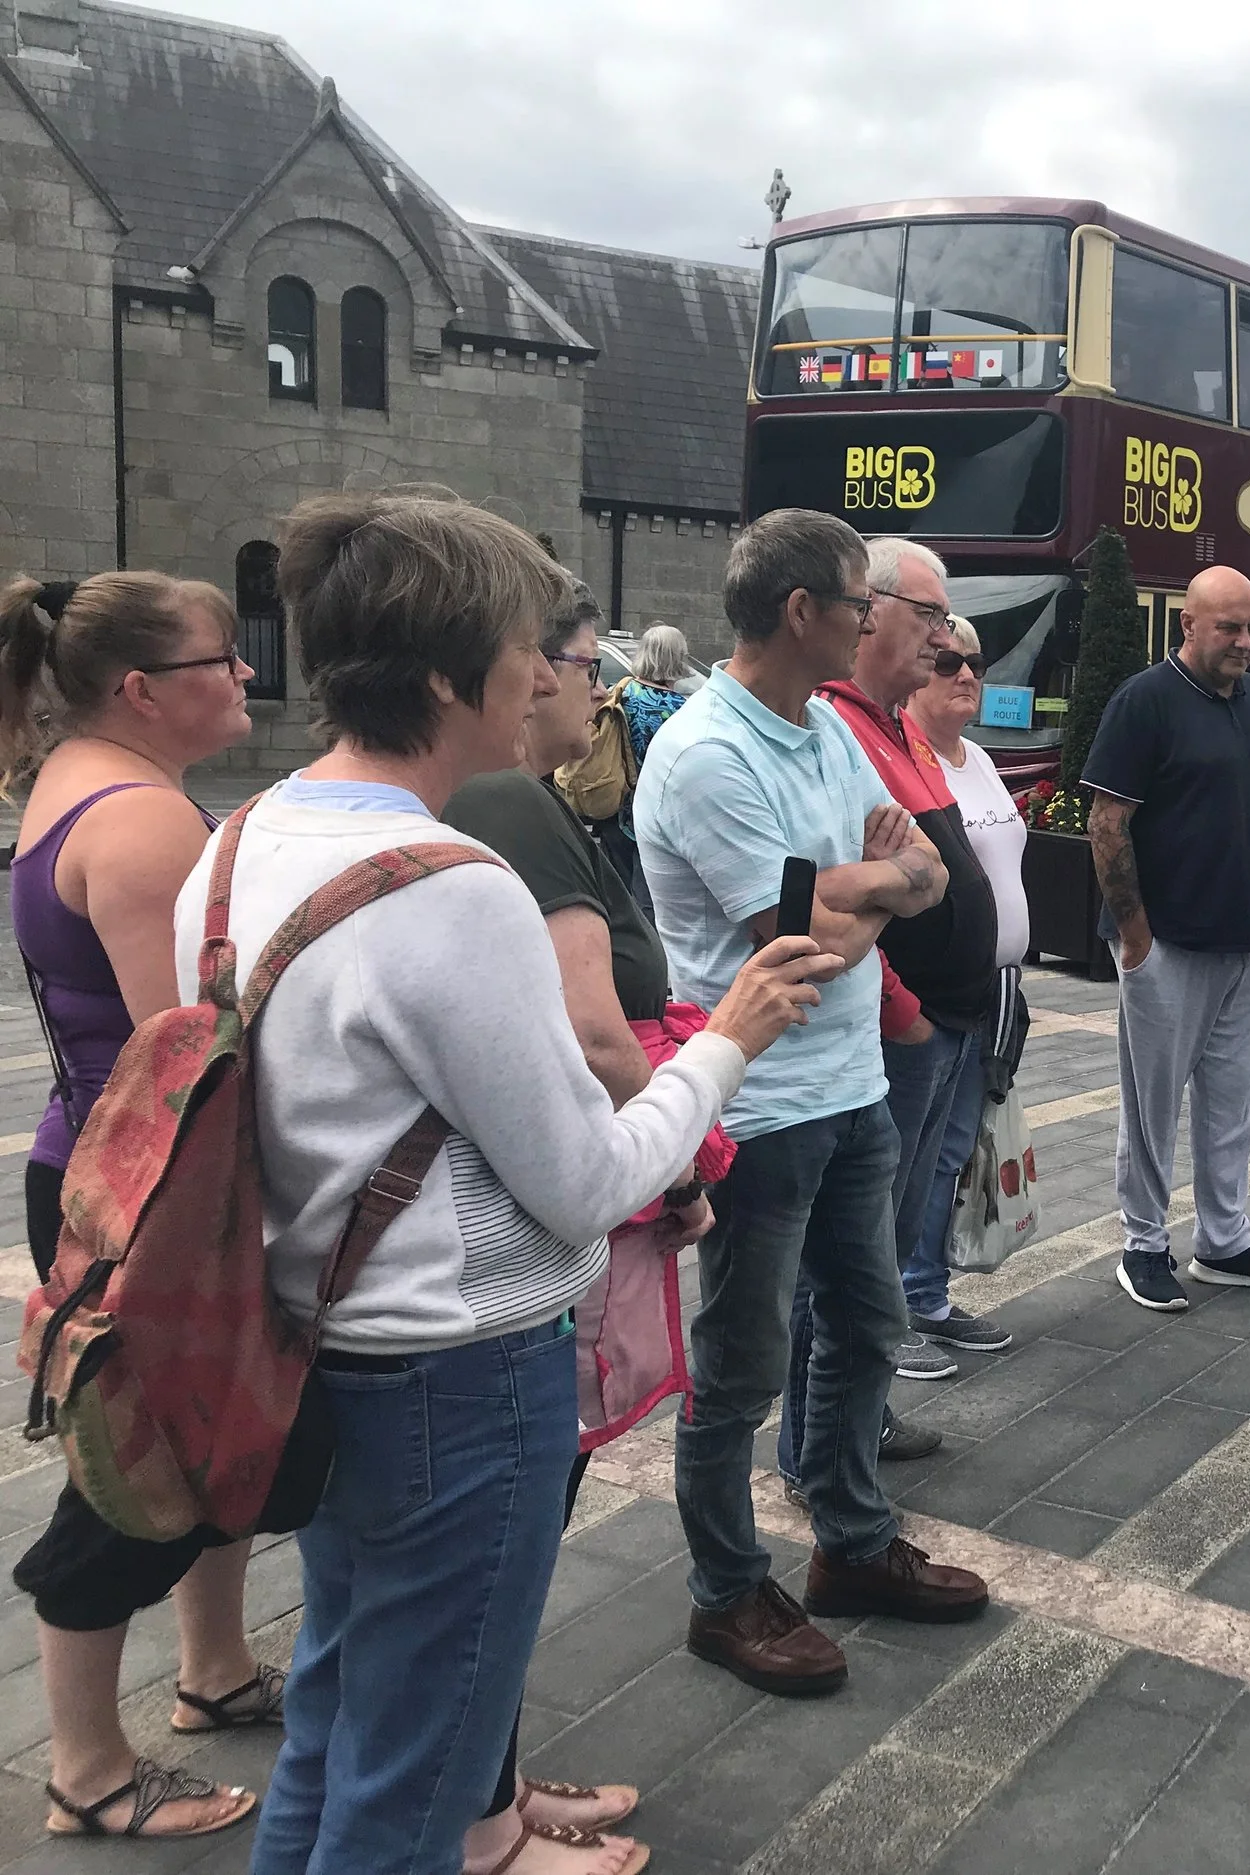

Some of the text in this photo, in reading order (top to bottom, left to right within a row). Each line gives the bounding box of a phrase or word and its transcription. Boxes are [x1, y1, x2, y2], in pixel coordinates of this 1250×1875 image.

[845, 446, 895, 478] BIG
[1125, 436, 1170, 487] BIG
[844, 480, 894, 509] BUS
[1124, 485, 1168, 530] BUS
[993, 710, 1022, 721] ROUTE
[997, 695, 1020, 706] BLUE
